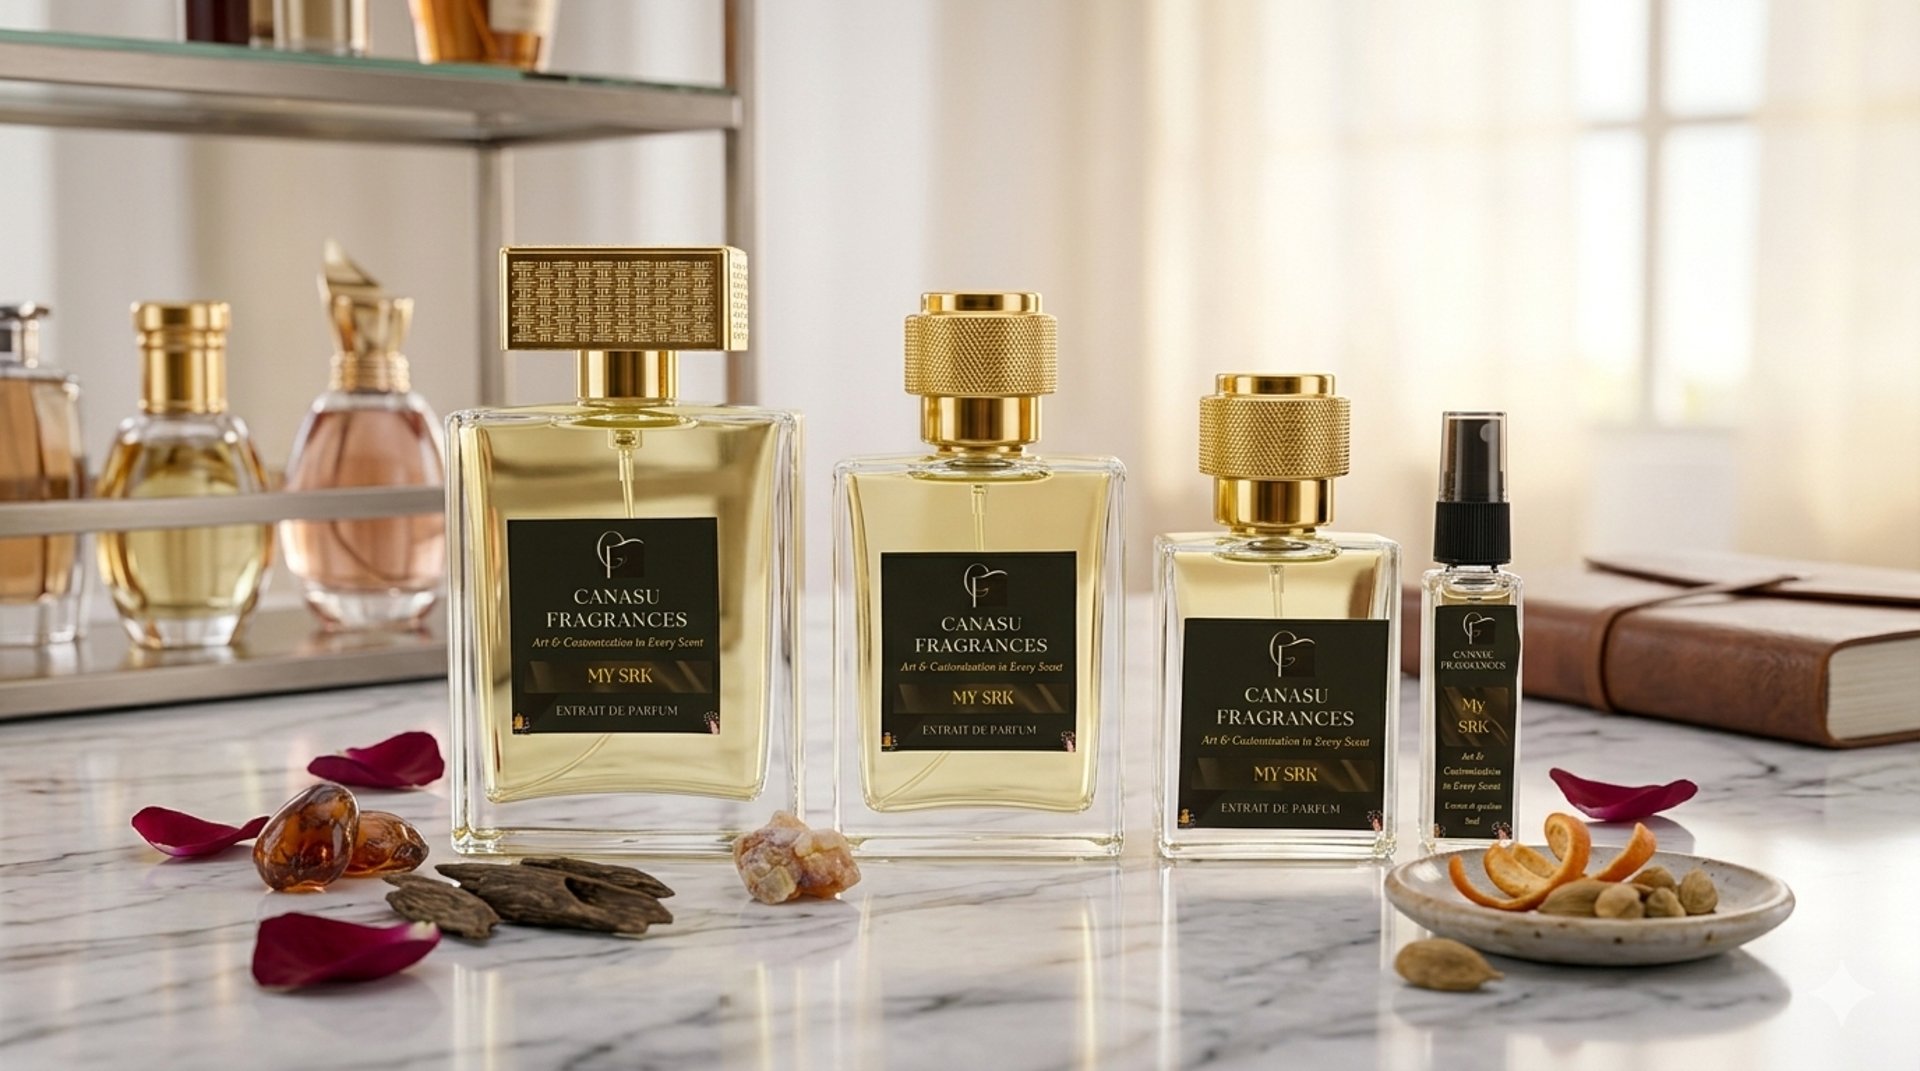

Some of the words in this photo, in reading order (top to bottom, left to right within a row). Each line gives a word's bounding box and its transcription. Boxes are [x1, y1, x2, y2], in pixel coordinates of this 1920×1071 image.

[573, 588, 661, 605] CANASU
[546, 611, 688, 628] FRAGRANCES
[941, 616, 1022, 632] CANASU
[532, 637, 549, 648] Art
[551, 637, 561, 648] &
[915, 637, 1048, 653] FRAGRANCES
[900, 661, 917, 672] Art
[918, 661, 928, 672] &
[588, 667, 617, 684] MY
[618, 667, 653, 684] SRK
[952, 690, 978, 705] MY
[982, 690, 1014, 705] SRK
[1244, 687, 1329, 704] CANASU
[556, 705, 606, 716] EXTRAIT
[608, 705, 625, 716] DE
[628, 705, 678, 716] PARFUM
[1216, 709, 1355, 726] FRAGRANCES
[922, 725, 969, 735] EXTRAIT
[972, 725, 987, 735] DE
[990, 725, 1037, 735] PARFUM
[1458, 719, 1490, 734] SRK
[1201, 735, 1218, 746] Art
[1219, 735, 1231, 746] &
[1253, 766, 1281, 782] MY
[1221, 803, 1270, 814] EXTRAIT
[1273, 803, 1289, 814] DE
